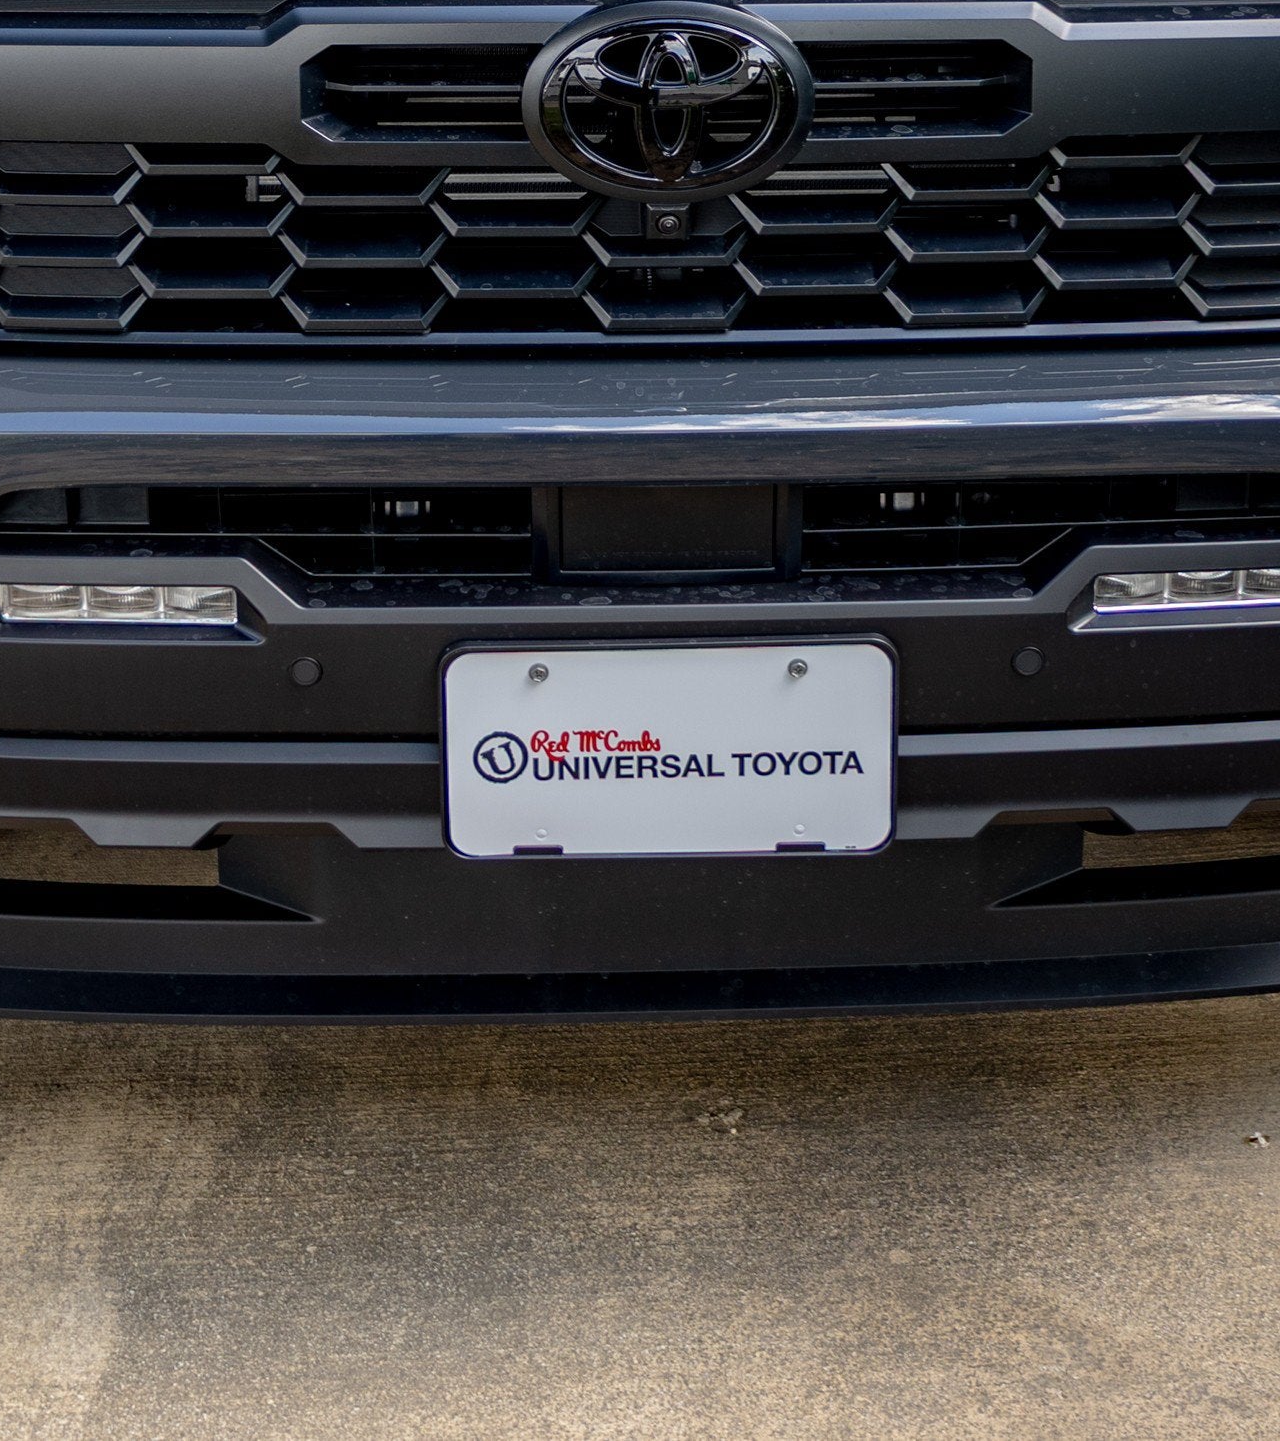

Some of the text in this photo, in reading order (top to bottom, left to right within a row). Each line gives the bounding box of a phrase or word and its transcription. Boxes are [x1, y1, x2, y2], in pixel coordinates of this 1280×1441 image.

[531, 730, 570, 762] Red
[532, 750, 864, 781] UNIVERSAL TOYOTA
